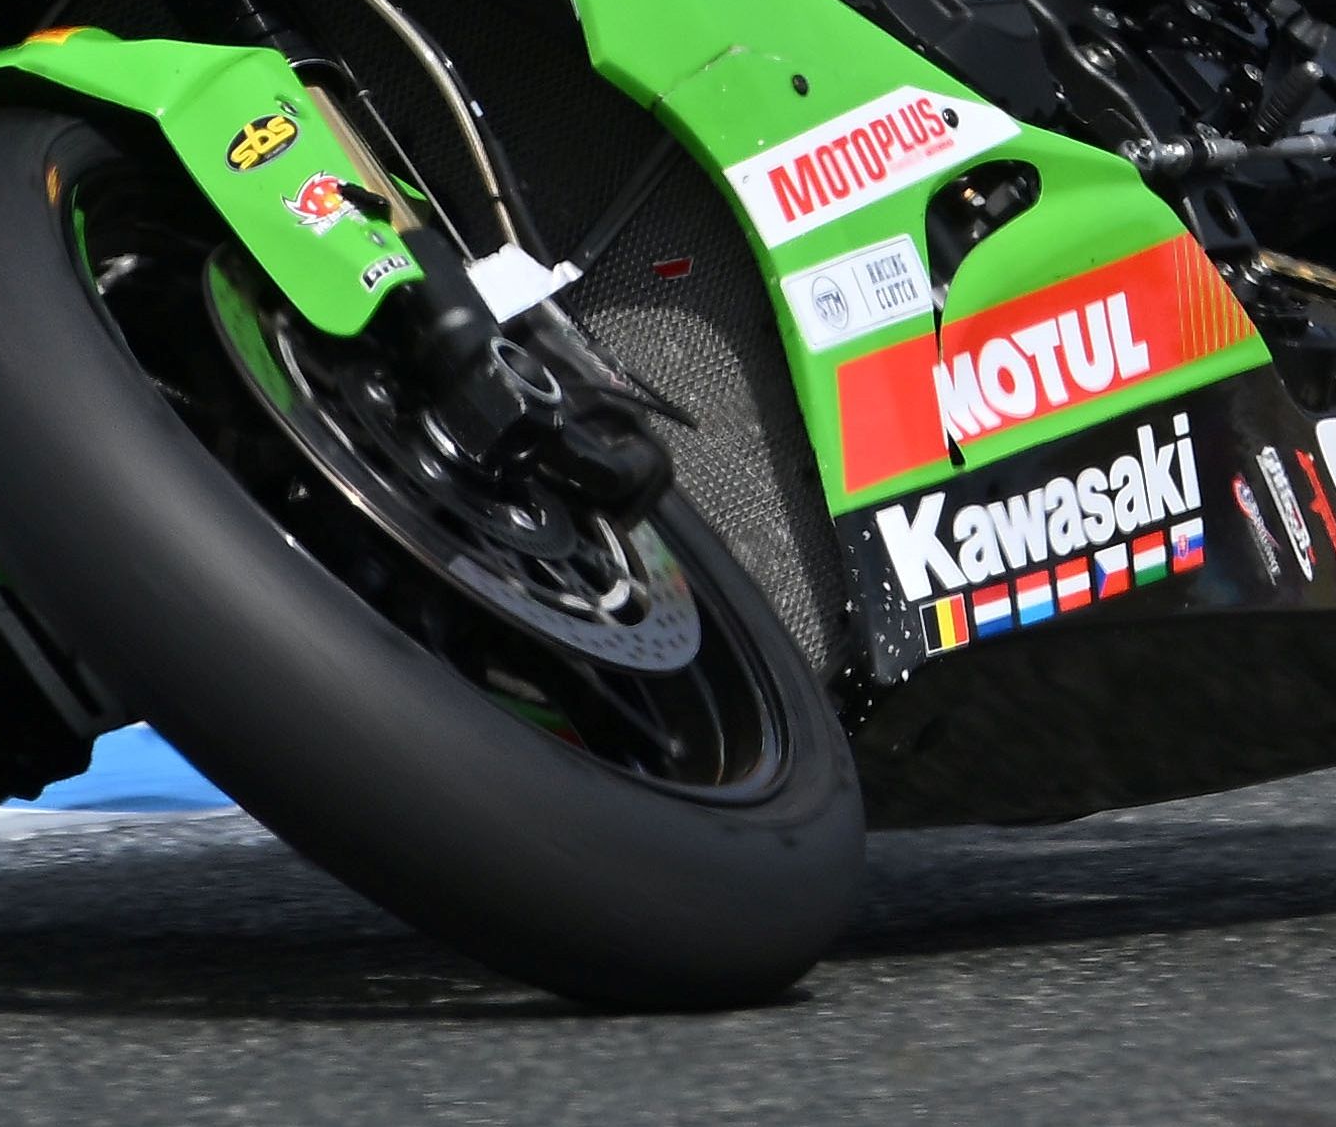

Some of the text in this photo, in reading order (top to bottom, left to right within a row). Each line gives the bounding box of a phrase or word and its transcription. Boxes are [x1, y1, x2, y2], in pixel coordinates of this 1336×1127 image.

[230, 115, 296, 170] sbs
[768, 98, 947, 223] MOTOPLUS
[867, 253, 908, 285] RACING
[875, 278, 919, 310] CLUTCH
[932, 291, 1150, 449] MOTUL
[875, 412, 1202, 601] Kawasaki
